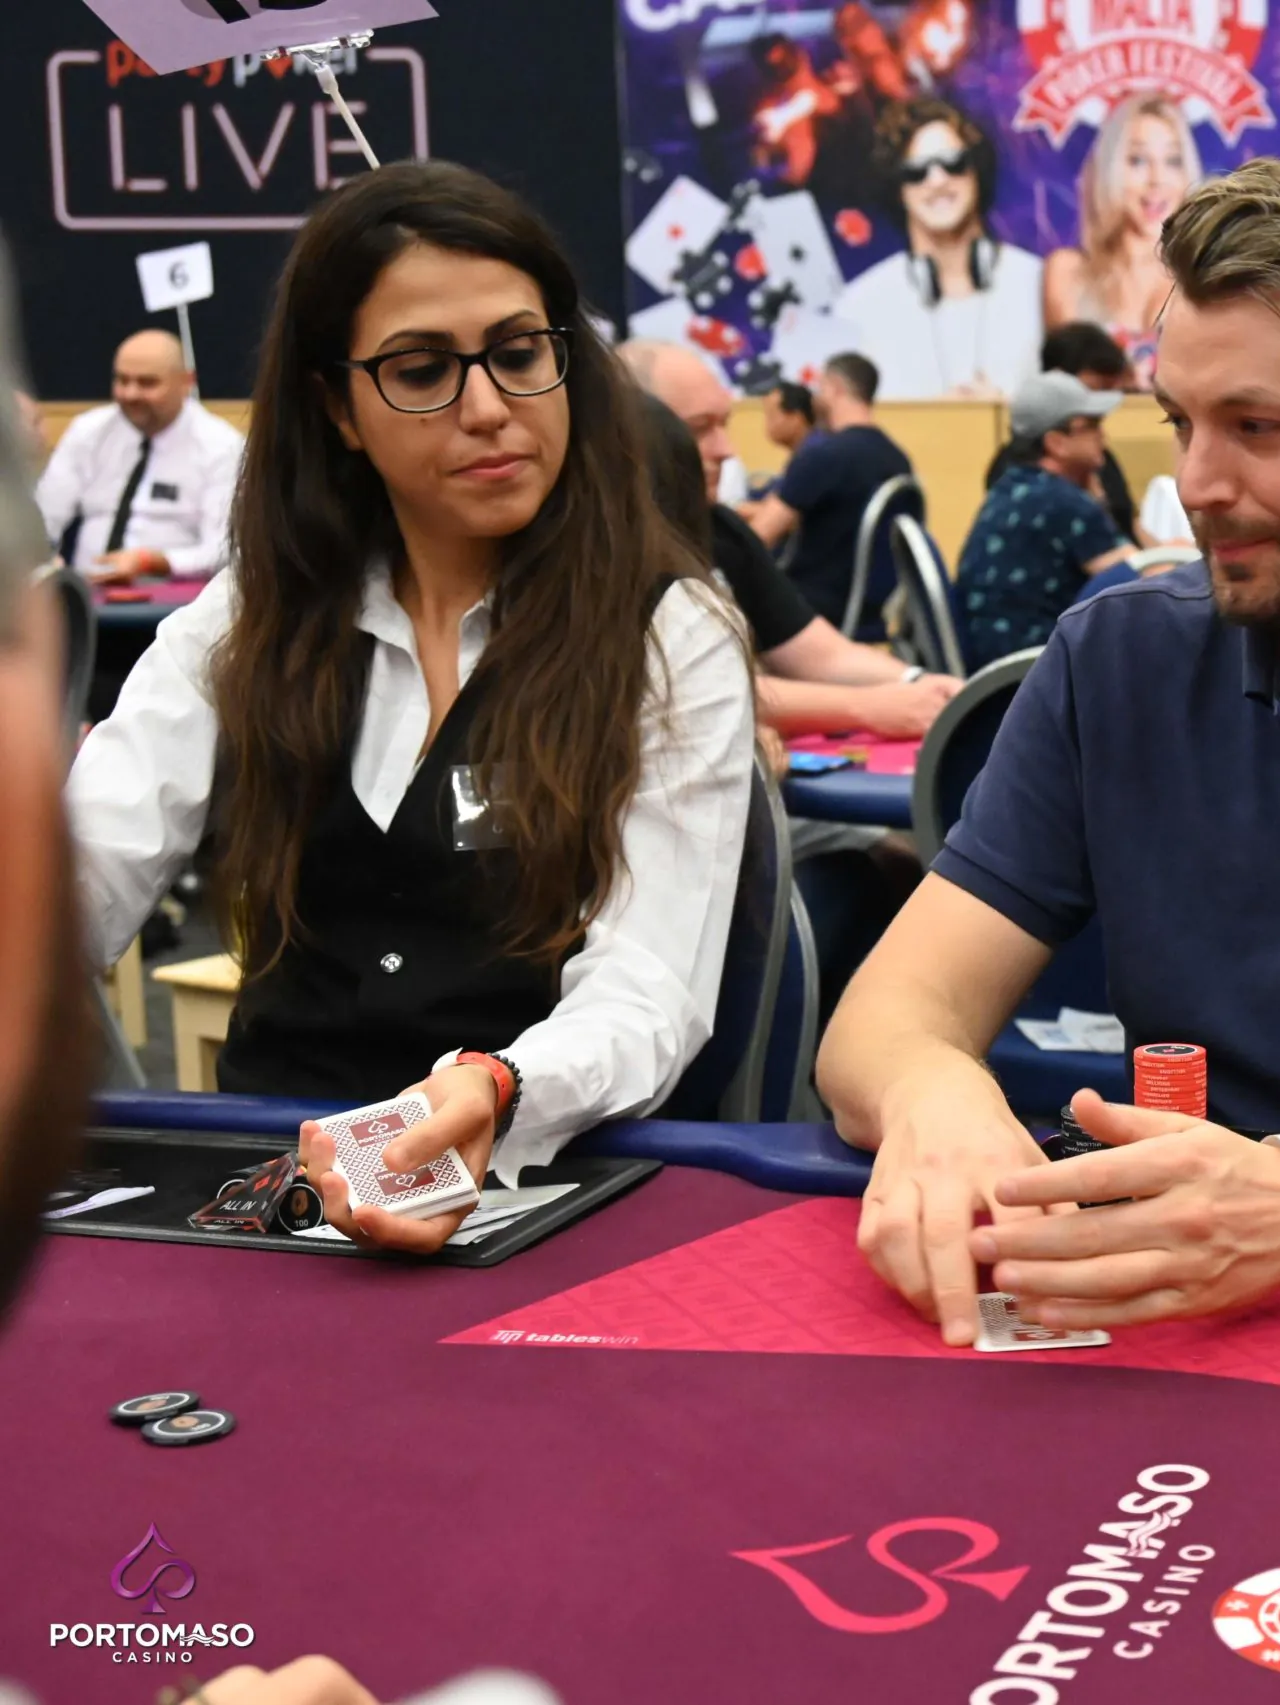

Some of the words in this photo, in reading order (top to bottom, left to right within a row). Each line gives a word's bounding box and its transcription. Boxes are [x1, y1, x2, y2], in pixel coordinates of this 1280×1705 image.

[108, 101, 367, 191] LIVE
[168, 260, 190, 291] 6
[219, 1200, 237, 1211] ALL
[239, 1200, 257, 1211] IN
[293, 1219, 309, 1228] 100
[968, 1463, 1211, 1705] ORTOMASO
[1112, 1544, 1216, 1660] CASINO
